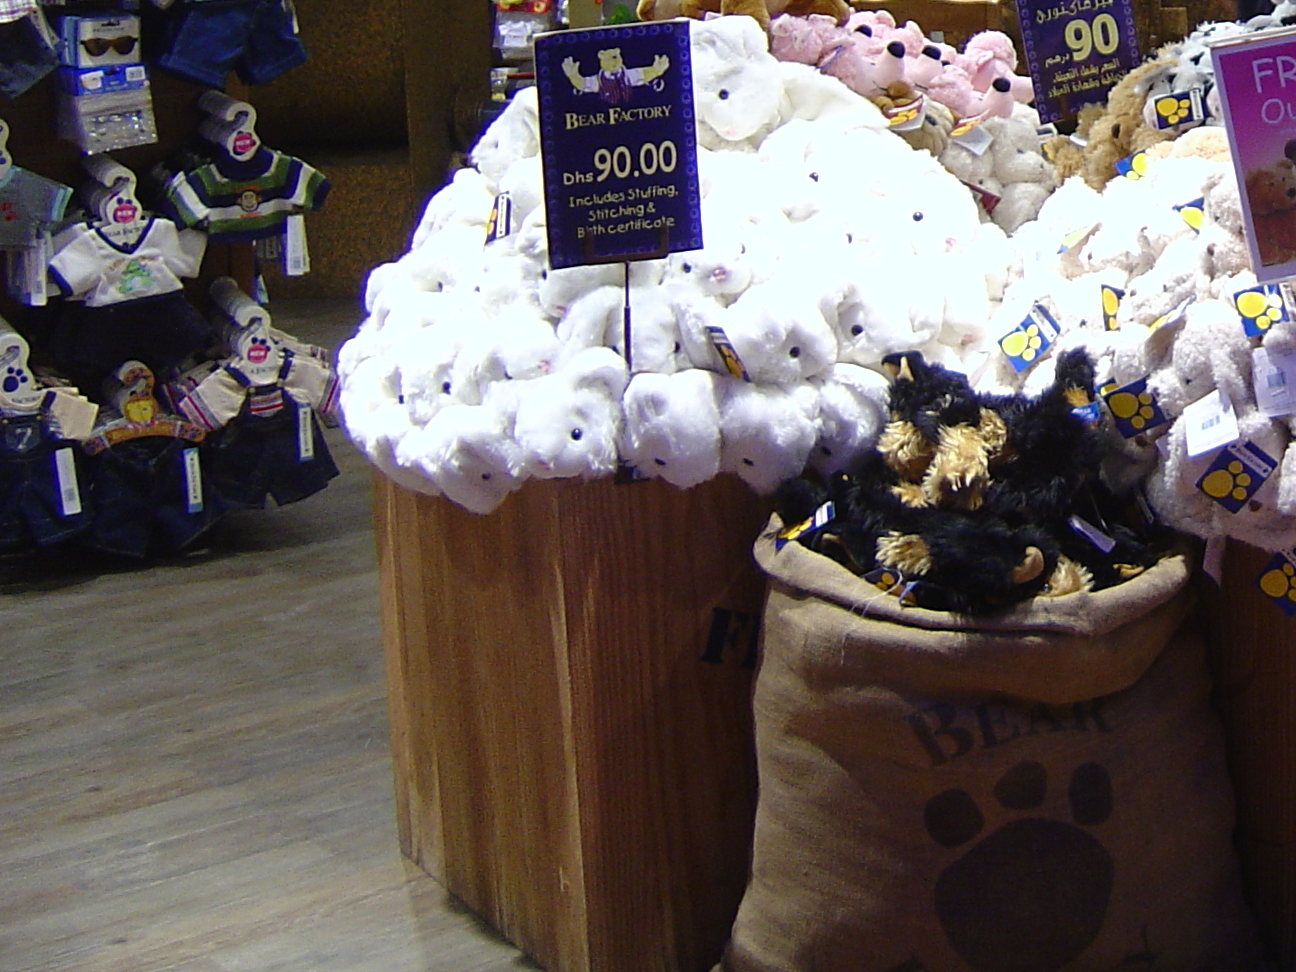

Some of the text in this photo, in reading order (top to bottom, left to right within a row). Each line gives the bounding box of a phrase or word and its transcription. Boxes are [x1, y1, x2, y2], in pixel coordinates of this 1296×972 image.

[1065, 13, 1119, 62] 90
[565, 105, 672, 130] BEAR FACTORY
[563, 140, 678, 186] Dhs 90.00
[568, 185, 679, 208] Includes Stuffing,
[588, 202, 656, 221] Stitching &
[904, 698, 1114, 767] BEAR
